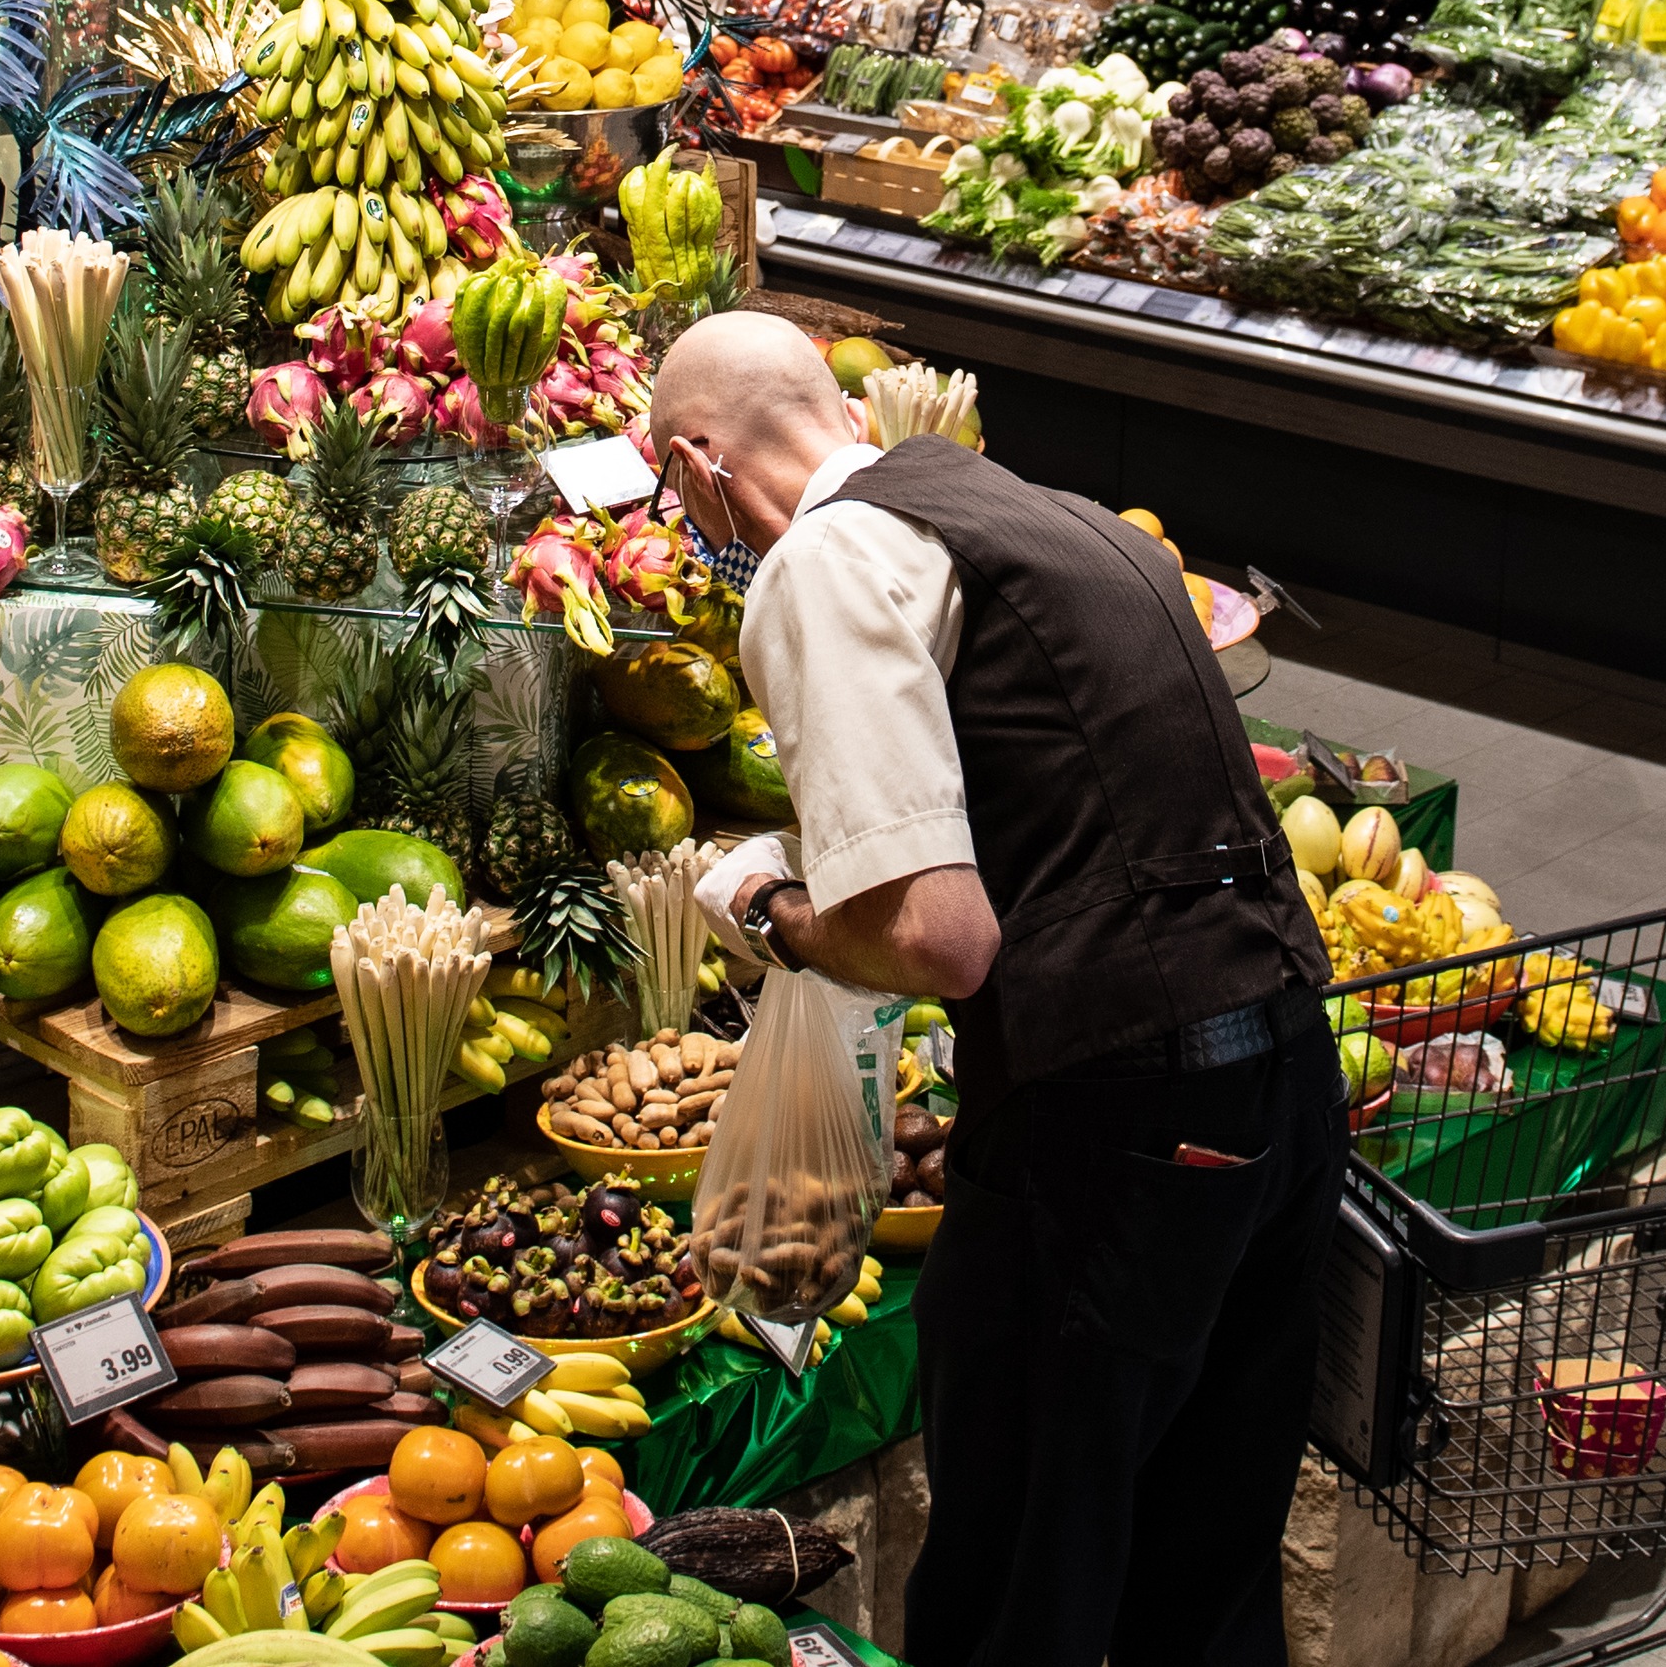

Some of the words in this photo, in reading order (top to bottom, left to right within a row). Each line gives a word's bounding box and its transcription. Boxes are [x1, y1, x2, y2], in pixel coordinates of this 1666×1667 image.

[165, 1111, 227, 1159] EPAL
[100, 1344, 153, 1381] 3.99
[493, 1347, 530, 1375] 0.99
[794, 1637, 839, 1667] 1.49
